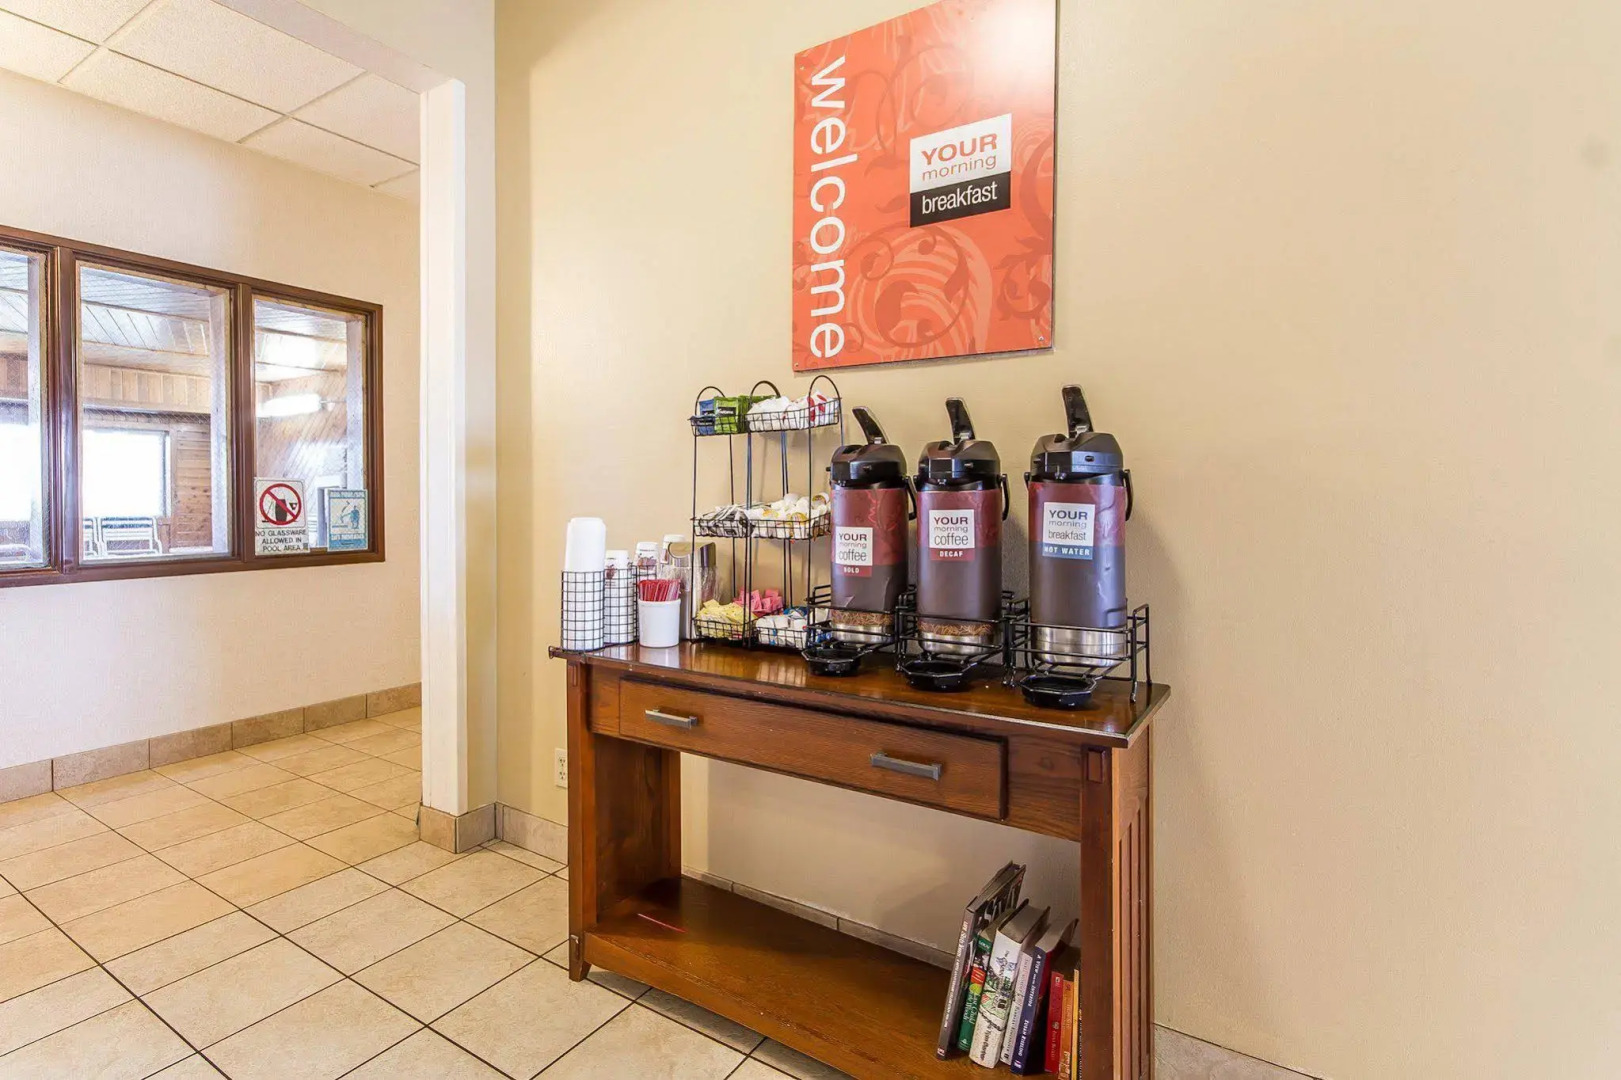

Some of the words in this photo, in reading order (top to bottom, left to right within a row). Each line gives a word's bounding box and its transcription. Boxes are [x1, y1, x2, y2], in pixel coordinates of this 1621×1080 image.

[921, 133, 997, 166] YOUR
[922, 155, 997, 181] morning
[922, 181, 998, 214] breakfast
[810, 56, 857, 358] welcome
[934, 517, 968, 525] YOUR
[1049, 510, 1088, 520] YOUR
[1049, 520, 1086, 529] morning
[838, 533, 867, 541] YOUR
[934, 533, 968, 546] coffee
[1048, 530, 1086, 541] breakfast
[838, 549, 867, 562] coffee
